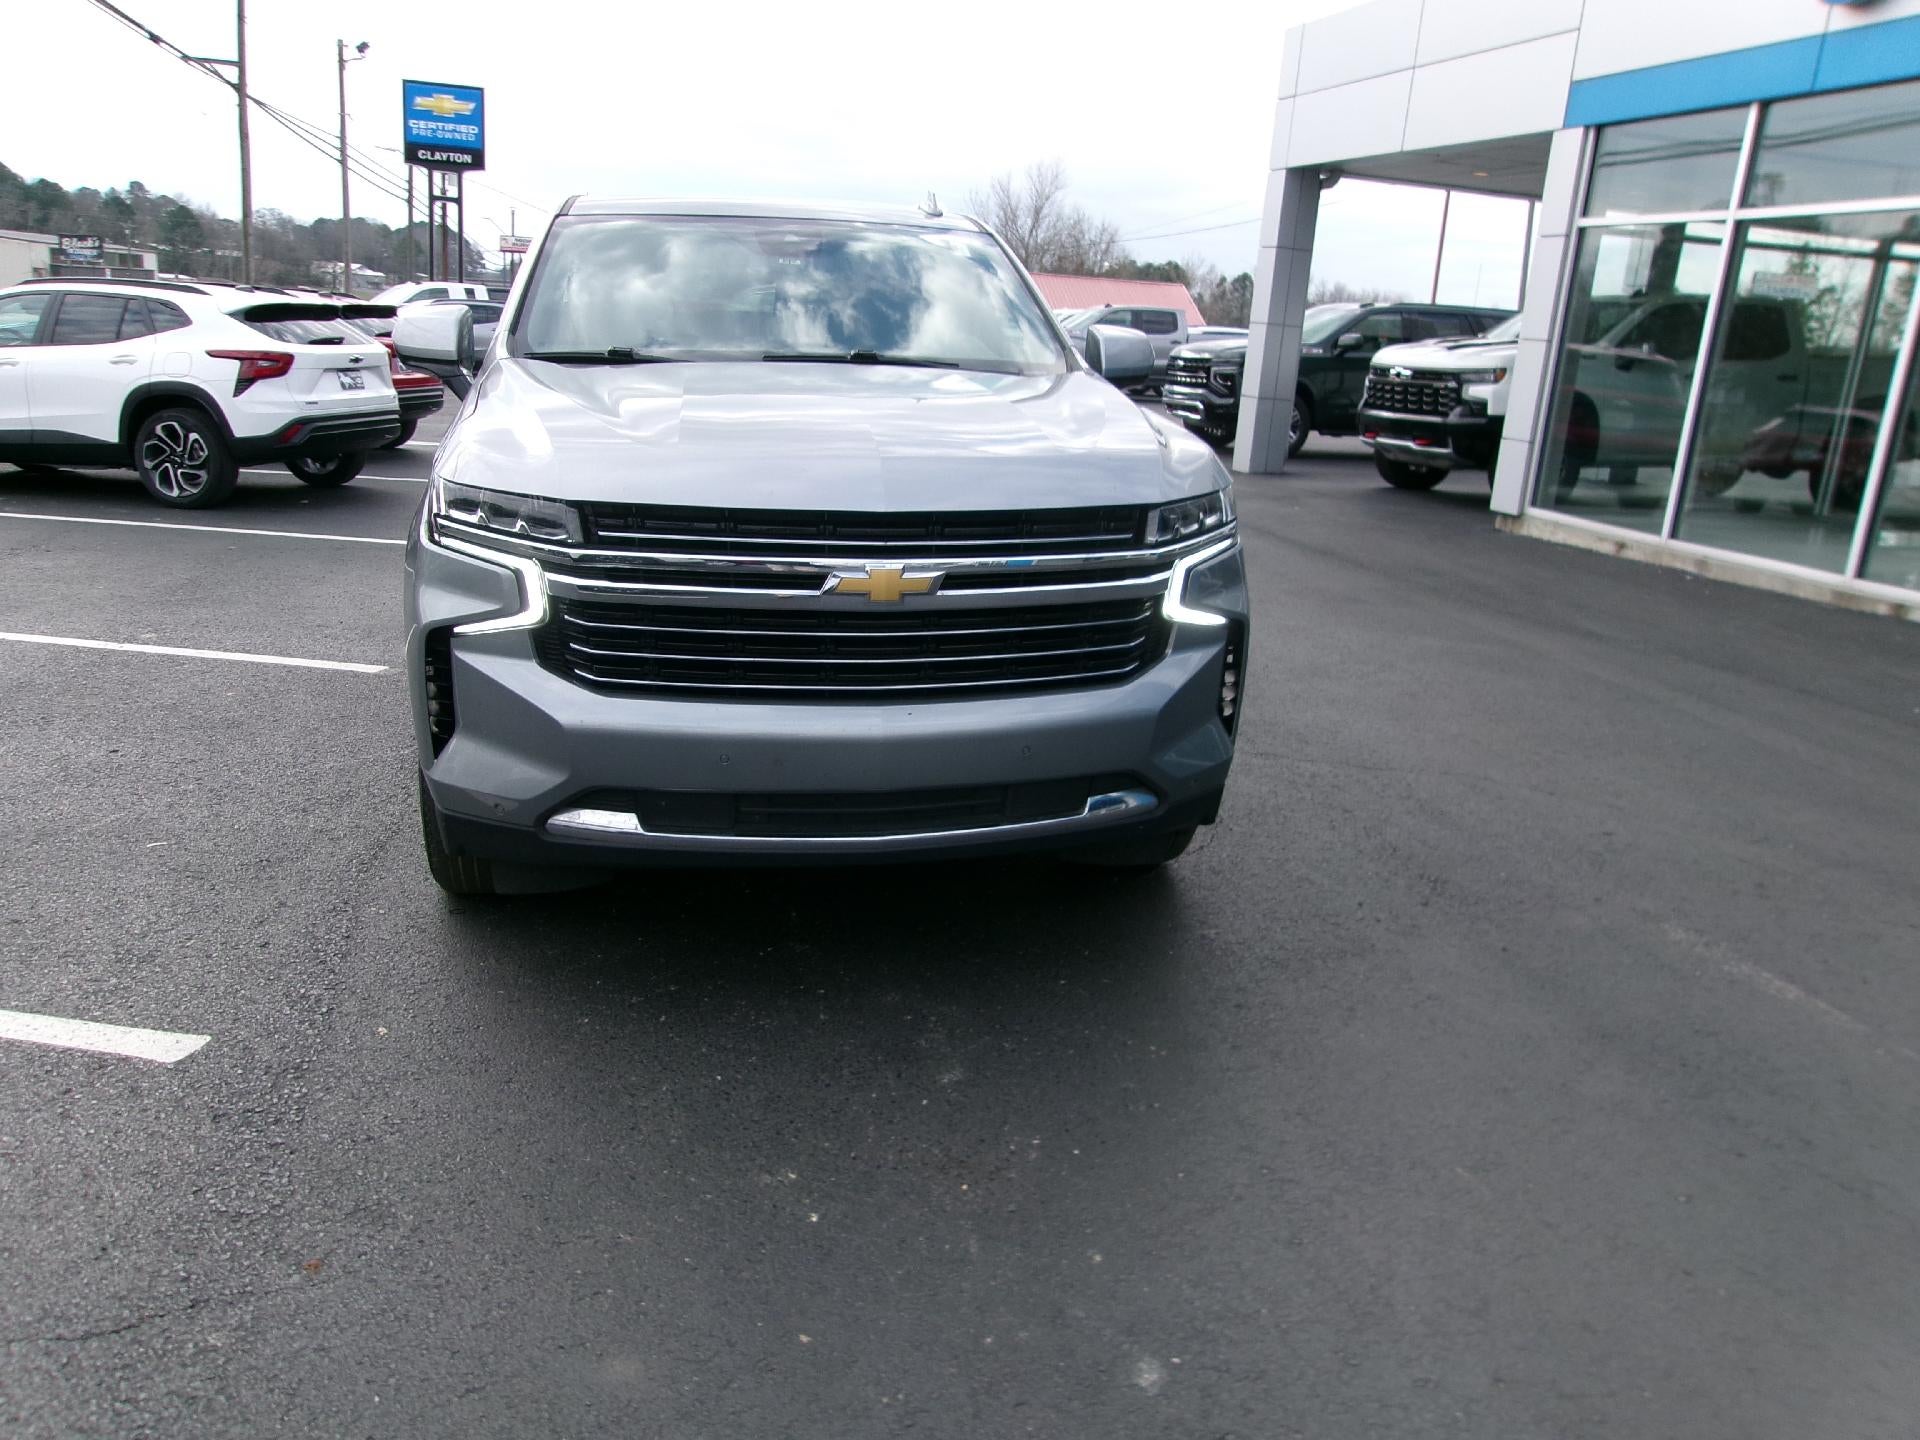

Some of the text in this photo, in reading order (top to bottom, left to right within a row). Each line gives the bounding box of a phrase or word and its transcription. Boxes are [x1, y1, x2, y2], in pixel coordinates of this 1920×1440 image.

[408, 120, 478, 133] CERTIFIED
[412, 128, 475, 141] PRE-OWNED
[417, 149, 472, 164] CLAYTON
